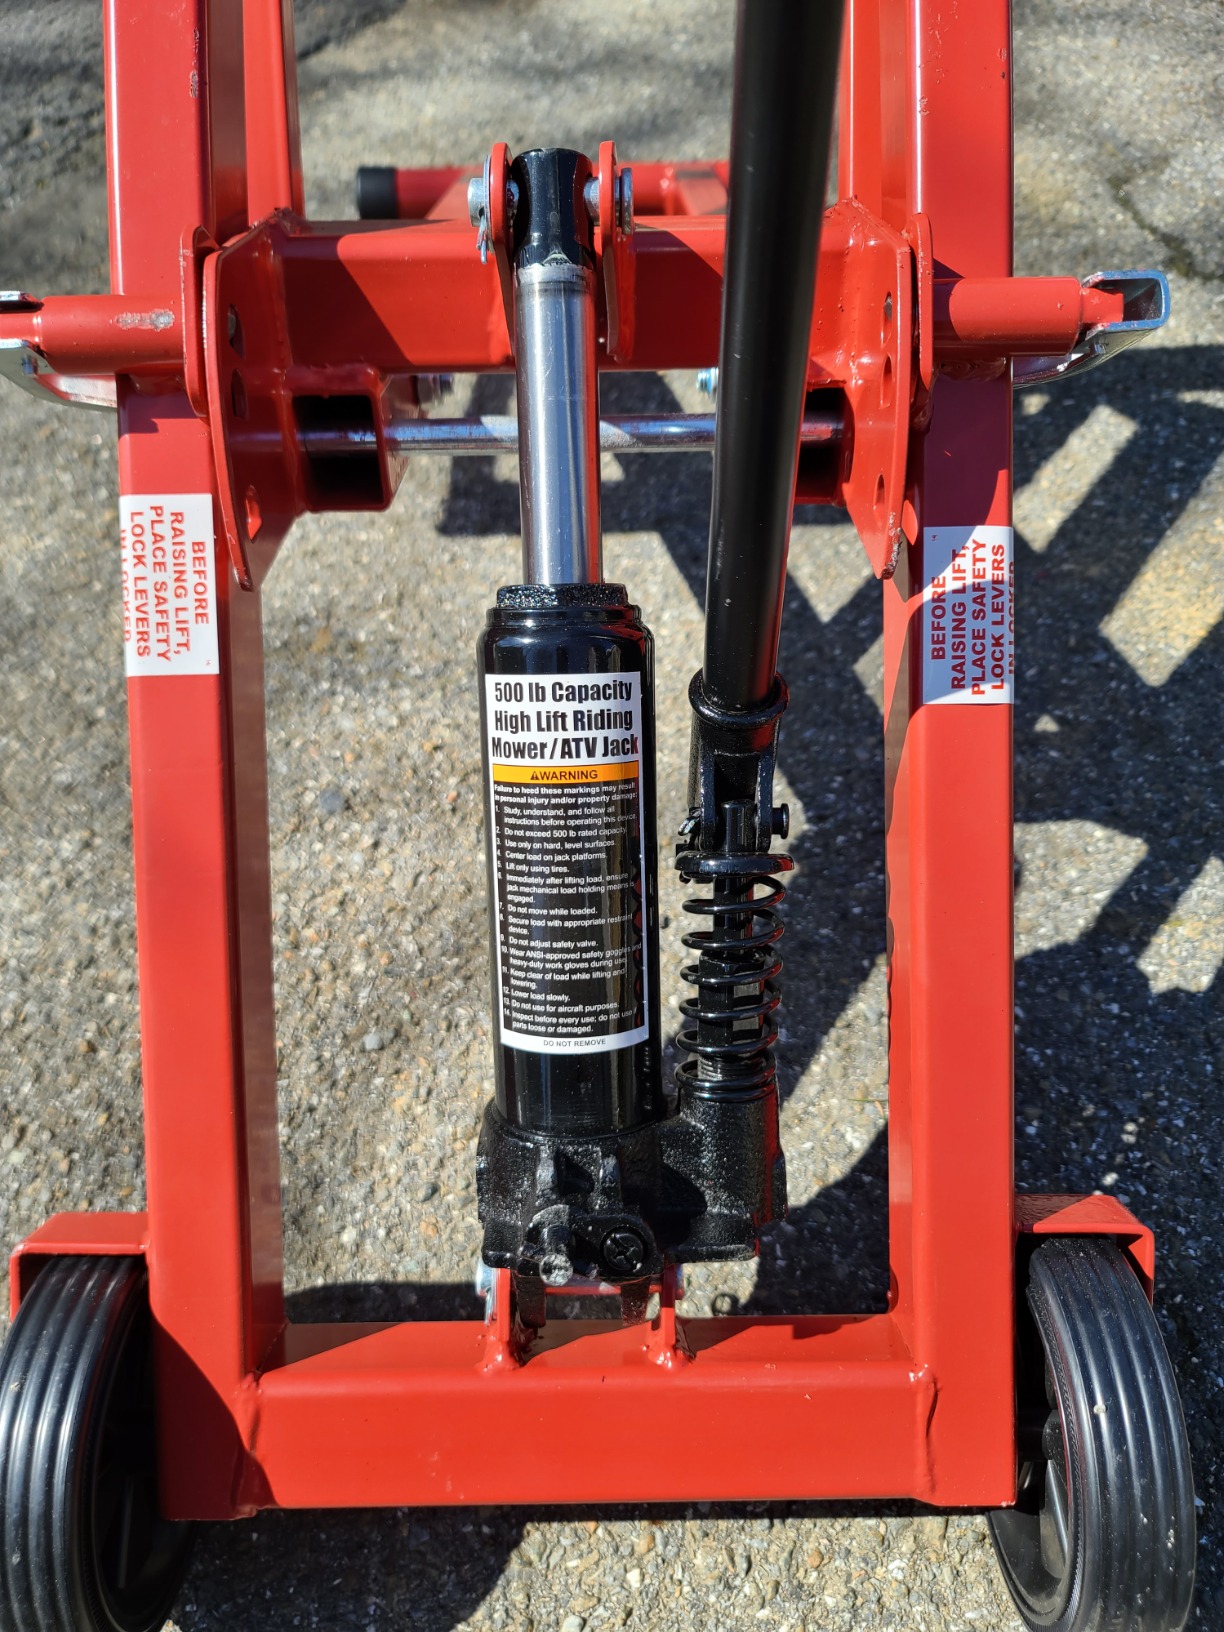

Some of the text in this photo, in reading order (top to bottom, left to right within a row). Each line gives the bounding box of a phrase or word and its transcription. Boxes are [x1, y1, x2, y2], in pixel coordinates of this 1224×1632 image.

[130, 512, 150, 658] LOCK LEVERS
[150, 505, 171, 661] PLACE SAFETY
[170, 512, 190, 655] RAISING LIFT,
[192, 541, 209, 624] BEFORE
[931, 575, 946, 660] BEFORE
[951, 545, 969, 689] RAISING LIFT,
[971, 539, 986, 695] PLACE SAFETY
[991, 544, 1005, 689] LOCK LEVERS
[495, 680, 632, 703] 500 lb Capacity
[495, 708, 633, 734] High Lift Riding
[492, 734, 638, 760] Mower/ATV Jack
[539, 770, 598, 780] WARNING
[494, 784, 512, 793] Failure
[564, 786, 599, 794] markings
[500, 795, 526, 803] personal
[528, 797, 549, 805] injury
[578, 795, 610, 804] property
[504, 806, 522, 816] Study,
[504, 817, 539, 825] instructions
[567, 817, 601, 826] operating
[603, 815, 615, 823] this
[578, 829, 597, 837] rated
[505, 839, 517, 847] Use
[518, 841, 532, 850] only
[544, 842, 563, 850] hard,
[505, 851, 526, 859] Center
[554, 854, 570, 862] jack
[572, 852, 608, 862] platforms.
[506, 862, 515, 870] Lift
[516, 864, 529, 873] only
[530, 865, 549, 874] using
[506, 874, 545, 885] Immediately
[565, 877, 585, 885] lifting
[606, 873, 628, 881] ensure
[507, 883, 518, 892] jack
[520, 886, 558, 894] mechanical
[579, 884, 605, 893] holding
[607, 882, 628, 891] means
[507, 894, 535, 903] engaged.
[508, 904, 516, 912] Do
[570, 907, 598, 915] loaded.
[508, 915, 529, 925] Secure
[564, 918, 605, 928] appropriate
[508, 926, 529, 935] device.
[509, 936, 517, 944] Do
[552, 941, 575, 949] safety
[510, 948, 525, 956] Wear
[526, 950, 580, 960] ANSI-approved
[510, 957, 544, 969] heavy-duty
[564, 961, 589, 970] gloves
[590, 959, 612, 967] during
[510, 968, 526, 978] Keep
[527, 971, 543, 979] clear
[571, 972, 590, 980] while
[592, 970, 611, 978] lifting
[613, 968, 625, 976] and
[511, 977, 537, 990] lowering.
[511, 989, 529, 998] Lower
[530, 992, 545, 1000] load
[546, 993, 570, 1003] slowly.
[511, 999, 520, 1007] Do
[558, 1004, 584, 1012] aircraft
[585, 1002, 619, 1012] purposes.
[512, 1011, 533, 1021] Inspect
[535, 1015, 557, 1023] before
[558, 1017, 579, 1025] every
[512, 1021, 527, 1030] parts
[528, 1023, 546, 1032] loose
[558, 1025, 593, 1034] damaged.
[574, 1038, 606, 1047] REMOVE
